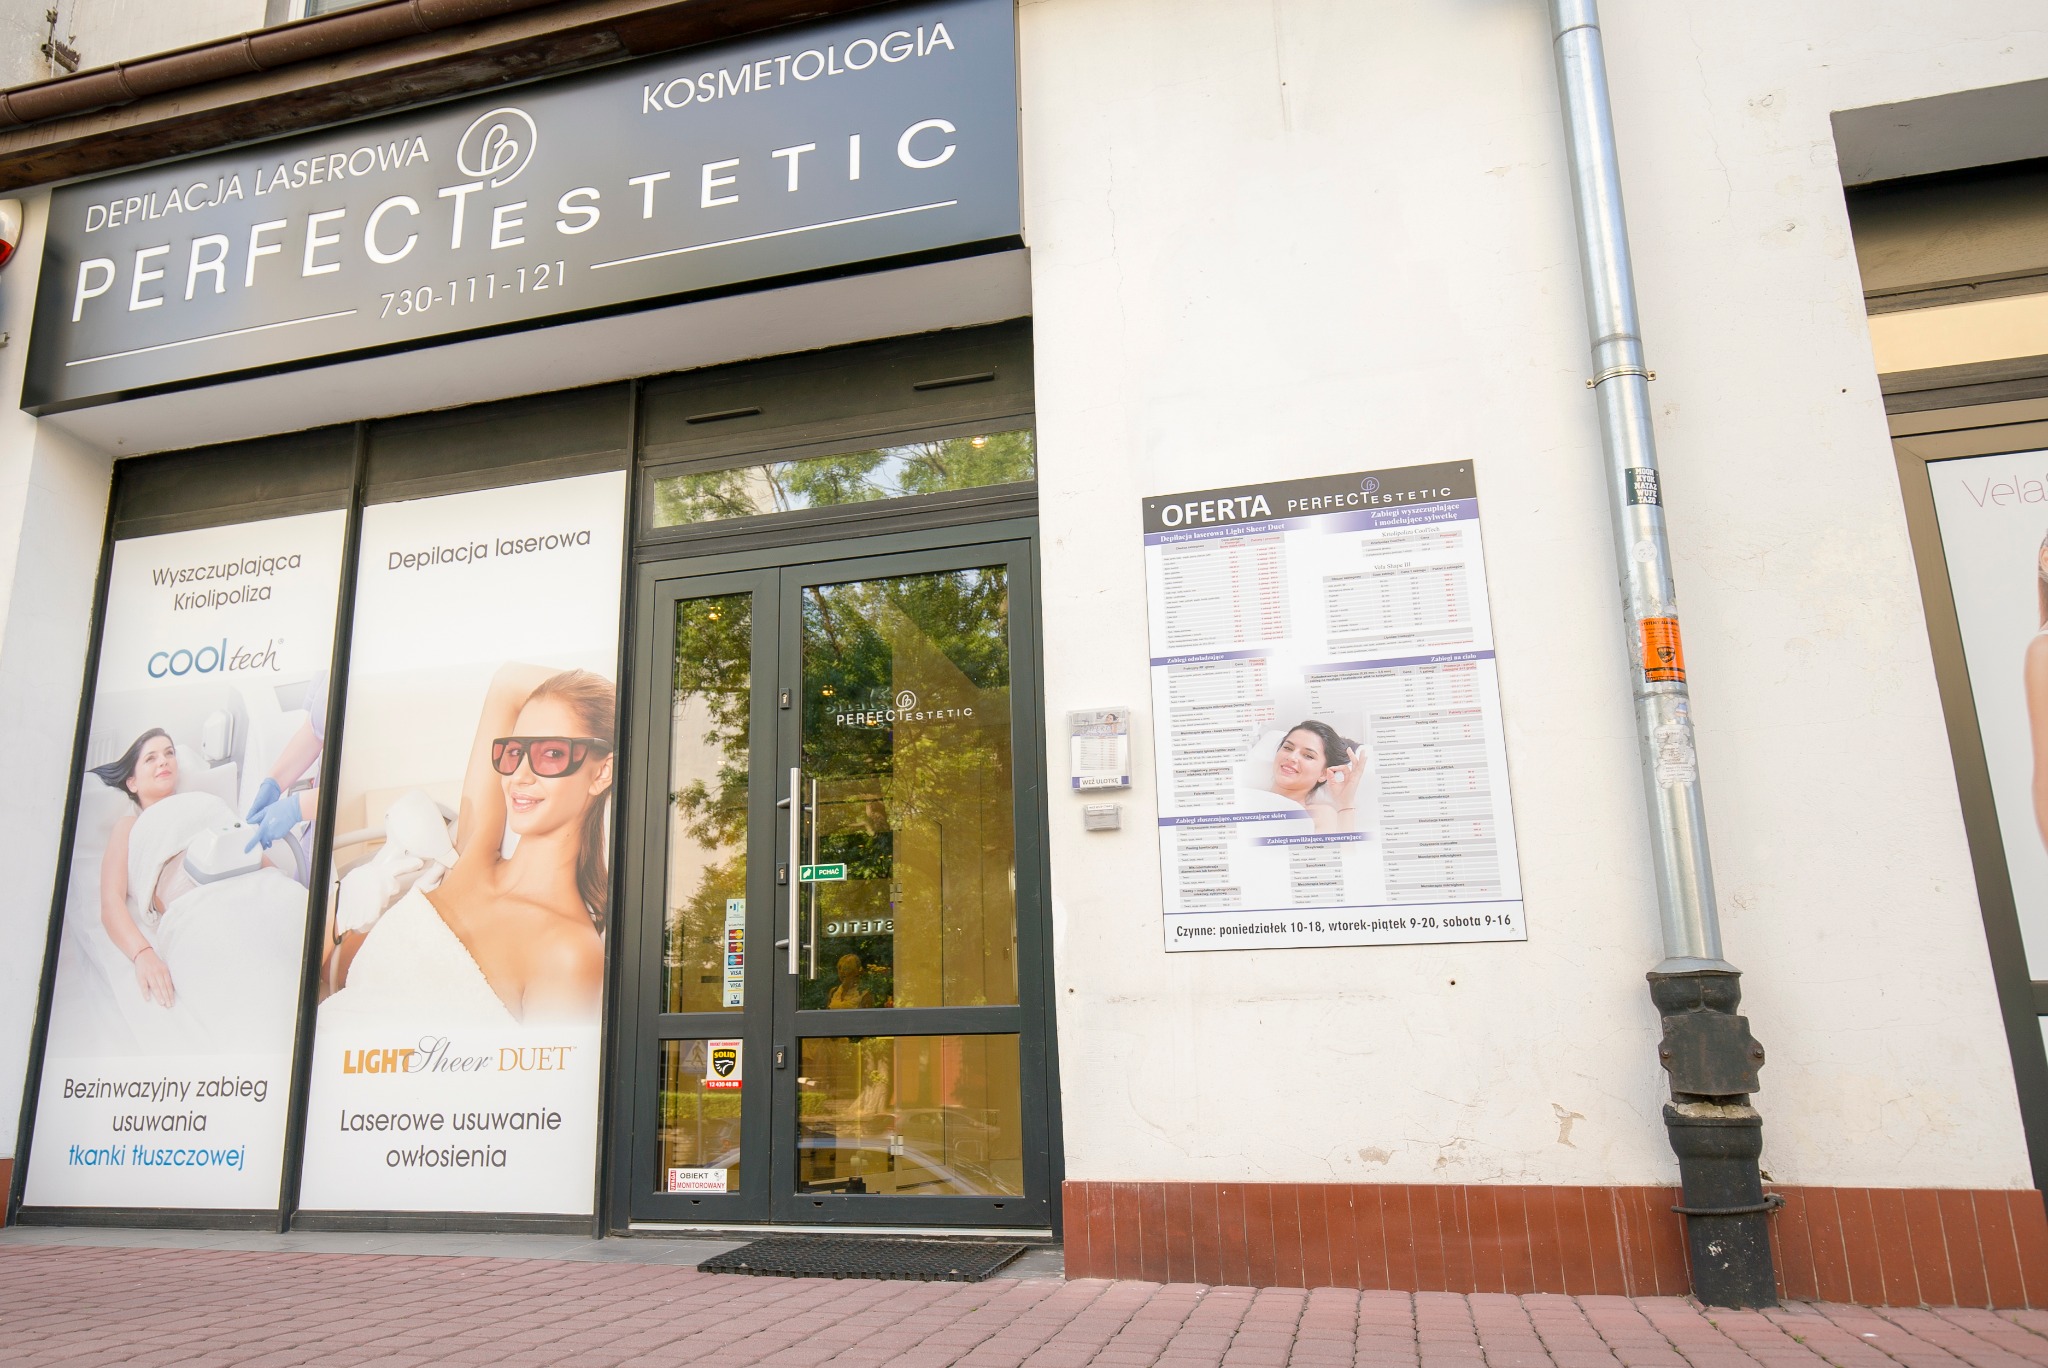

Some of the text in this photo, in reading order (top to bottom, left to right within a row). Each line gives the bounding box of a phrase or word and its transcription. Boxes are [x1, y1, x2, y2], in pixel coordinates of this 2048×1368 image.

[641, 21, 956, 116] KOSMETOLOGIA
[84, 135, 430, 234] DEPILACJA LASEROWA
[378, 260, 569, 321] 730-111-121
[1961, 474, 2048, 508] Vela
[1161, 494, 1272, 527] OFERTA
[1370, 503, 1460, 519] Zabiegi wyszczuplające
[1379, 516, 1423, 526] modelujące
[1424, 512, 1458, 522] sylwetkę
[1160, 523, 1285, 543] Depilacja laserowa Light Sheer Duet
[388, 529, 592, 573] Depilacja laserowa
[152, 553, 302, 588] Wyszczuplająca
[173, 583, 272, 611] Kriolipoliza
[818, 867, 840, 876] PCHAĆ
[1176, 914, 1511, 938] Czynne: poniedziałek 10-18, wtorek-piątek 9-20, sobota 9-16
[497, 1046, 571, 1073] DUET
[713, 1051, 735, 1059] SOLID
[63, 1076, 268, 1103] Bezinwazyjny zabieg
[112, 1112, 207, 1133] usuwania
[340, 1108, 562, 1132] Laserowe usuwanie
[69, 1144, 246, 1171] tkanki tłuszczowej
[385, 1144, 507, 1168] owłosienia
